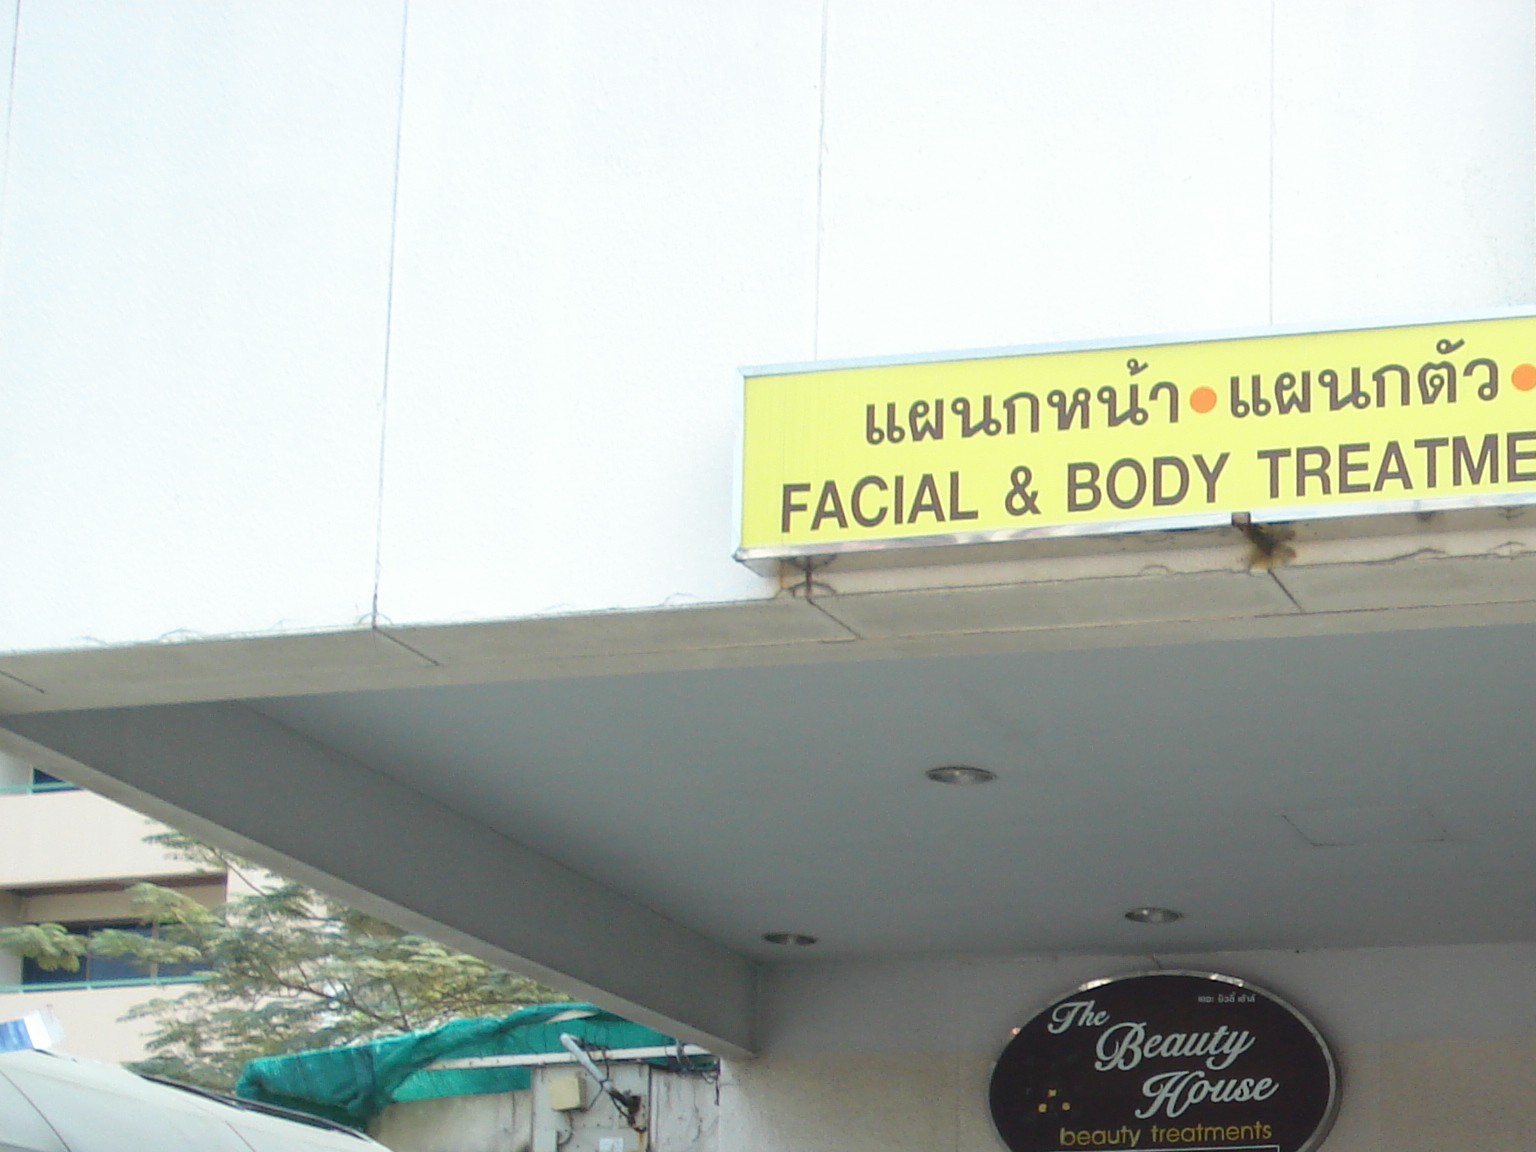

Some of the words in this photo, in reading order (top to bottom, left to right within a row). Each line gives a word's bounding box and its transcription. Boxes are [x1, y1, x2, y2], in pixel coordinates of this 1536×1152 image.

[866, 358, 1180, 446] แผนกหน้า
[1230, 339, 1499, 419] แผนกตัว
[781, 471, 979, 534] FACIAL
[1004, 465, 1042, 517] &
[1067, 452, 1231, 514] BODY
[1048, 1000, 1110, 1034] The
[1095, 1021, 1255, 1071] Beauty
[1135, 1070, 1279, 1119] House
[1060, 1125, 1141, 1147] beauty
[1152, 1121, 1272, 1143] treatments
